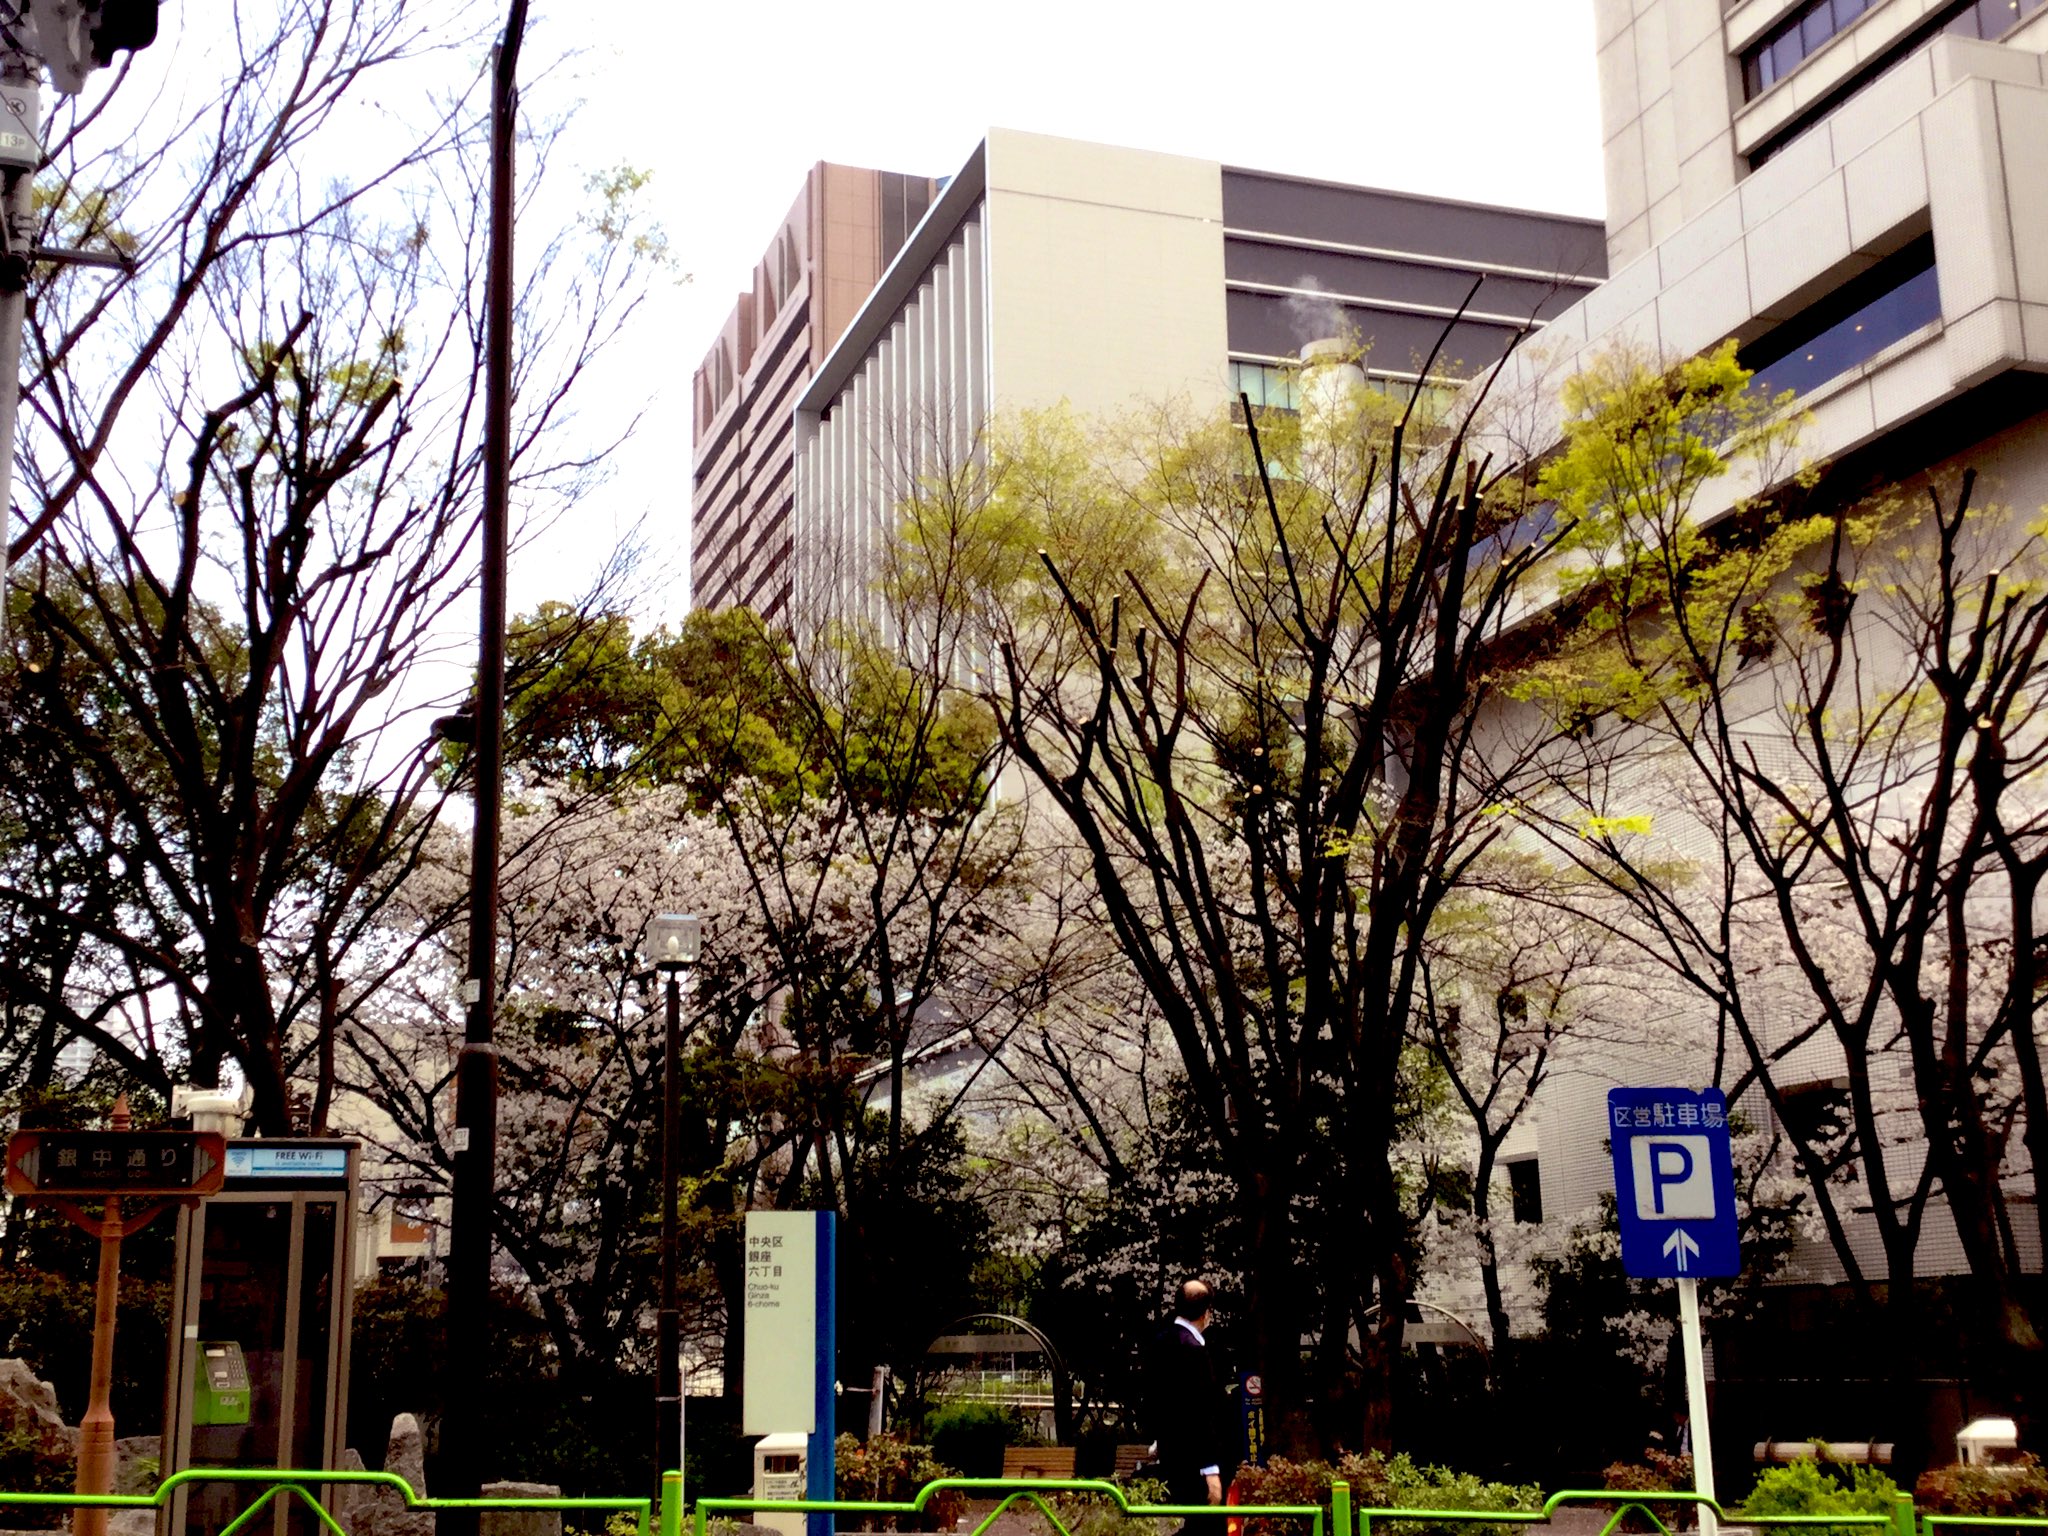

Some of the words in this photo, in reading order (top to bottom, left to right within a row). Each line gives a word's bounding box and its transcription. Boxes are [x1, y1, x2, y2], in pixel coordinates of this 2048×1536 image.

[1614, 1102, 1725, 1128] 区営駐車場
[57, 1148, 177, 1168] 銀中通り
[275, 1151, 295, 1160] FREE
[298, 1151, 323, 1160] Wi-Fi
[1649, 1143, 1693, 1214] P
[749, 1236, 783, 1248] 中央区
[748, 1251, 771, 1262] 銀座
[748, 1266, 782, 1277] 六丁目
